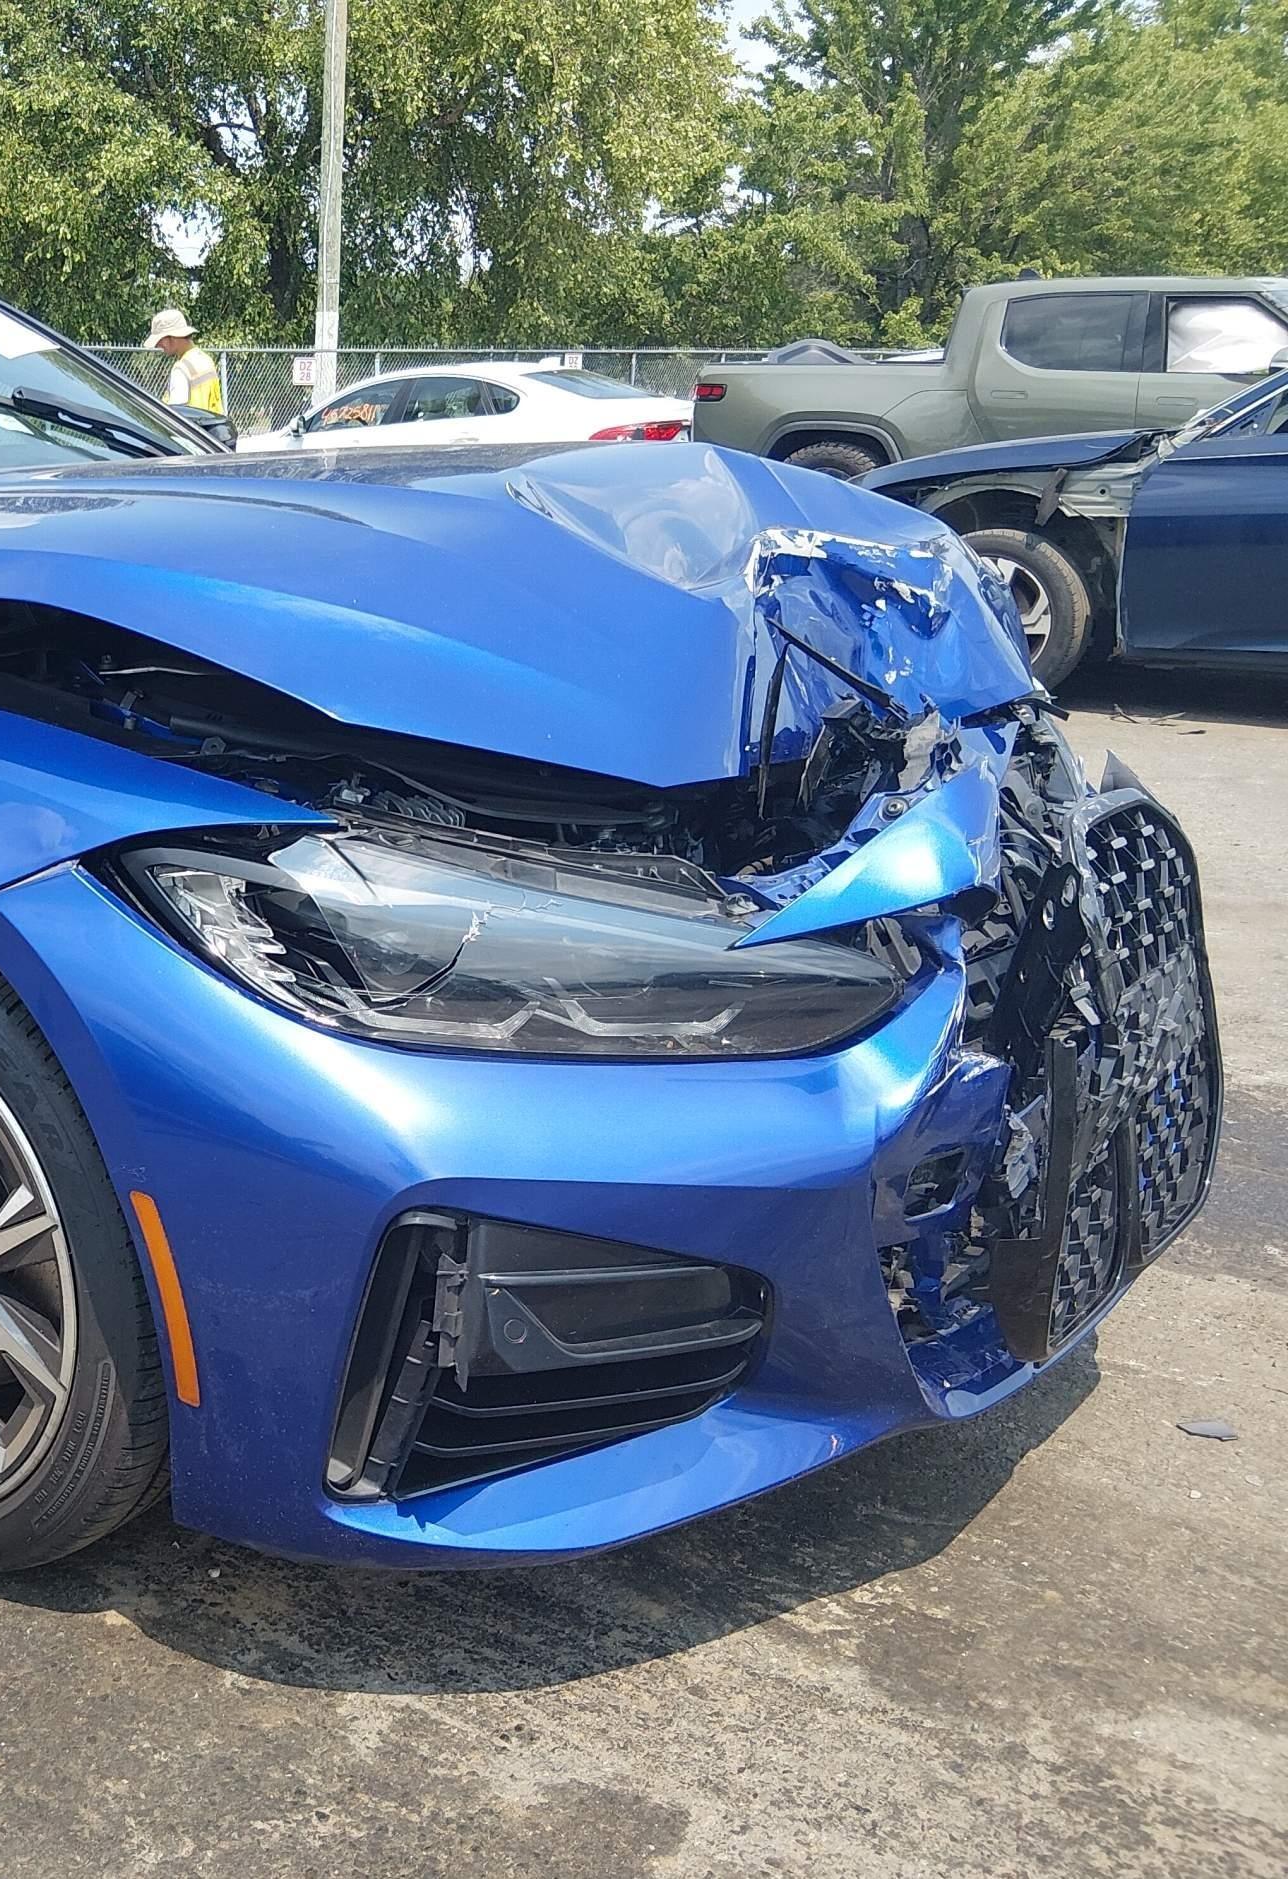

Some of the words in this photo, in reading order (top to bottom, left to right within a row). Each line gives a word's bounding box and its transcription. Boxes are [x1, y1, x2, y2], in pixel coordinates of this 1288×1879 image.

[568, 356, 579, 365] DZ
[299, 361, 313, 371] DZ
[299, 372, 311, 381] 28
